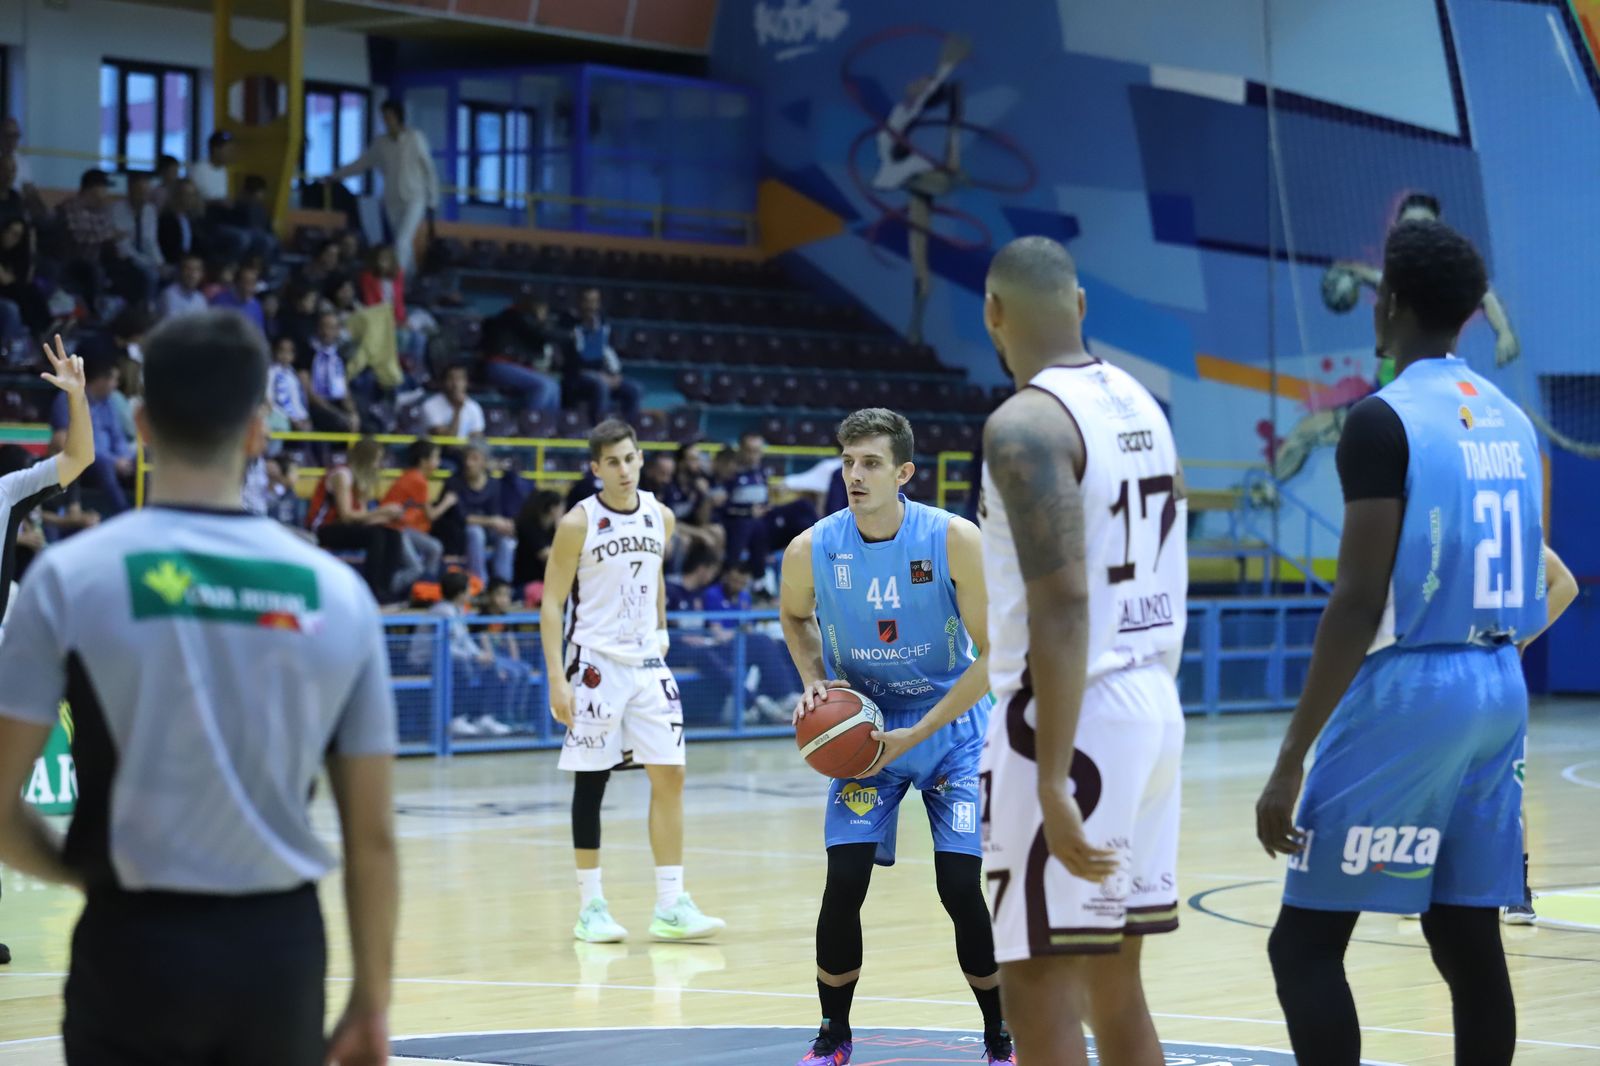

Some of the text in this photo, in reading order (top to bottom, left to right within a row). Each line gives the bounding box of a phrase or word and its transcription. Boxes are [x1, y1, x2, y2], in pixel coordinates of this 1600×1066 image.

[1459, 441, 1526, 480] TRAORE
[1107, 475, 1177, 584] 17
[1472, 489, 1523, 608] 21
[630, 561, 643, 579] 7
[866, 575, 902, 610] 44
[850, 643, 932, 661] INNOVACHEF
[670, 722, 684, 747] 7
[834, 790, 884, 806] ZAMORA
[1341, 825, 1441, 875] gaza
[986, 868, 1011, 923] 7
